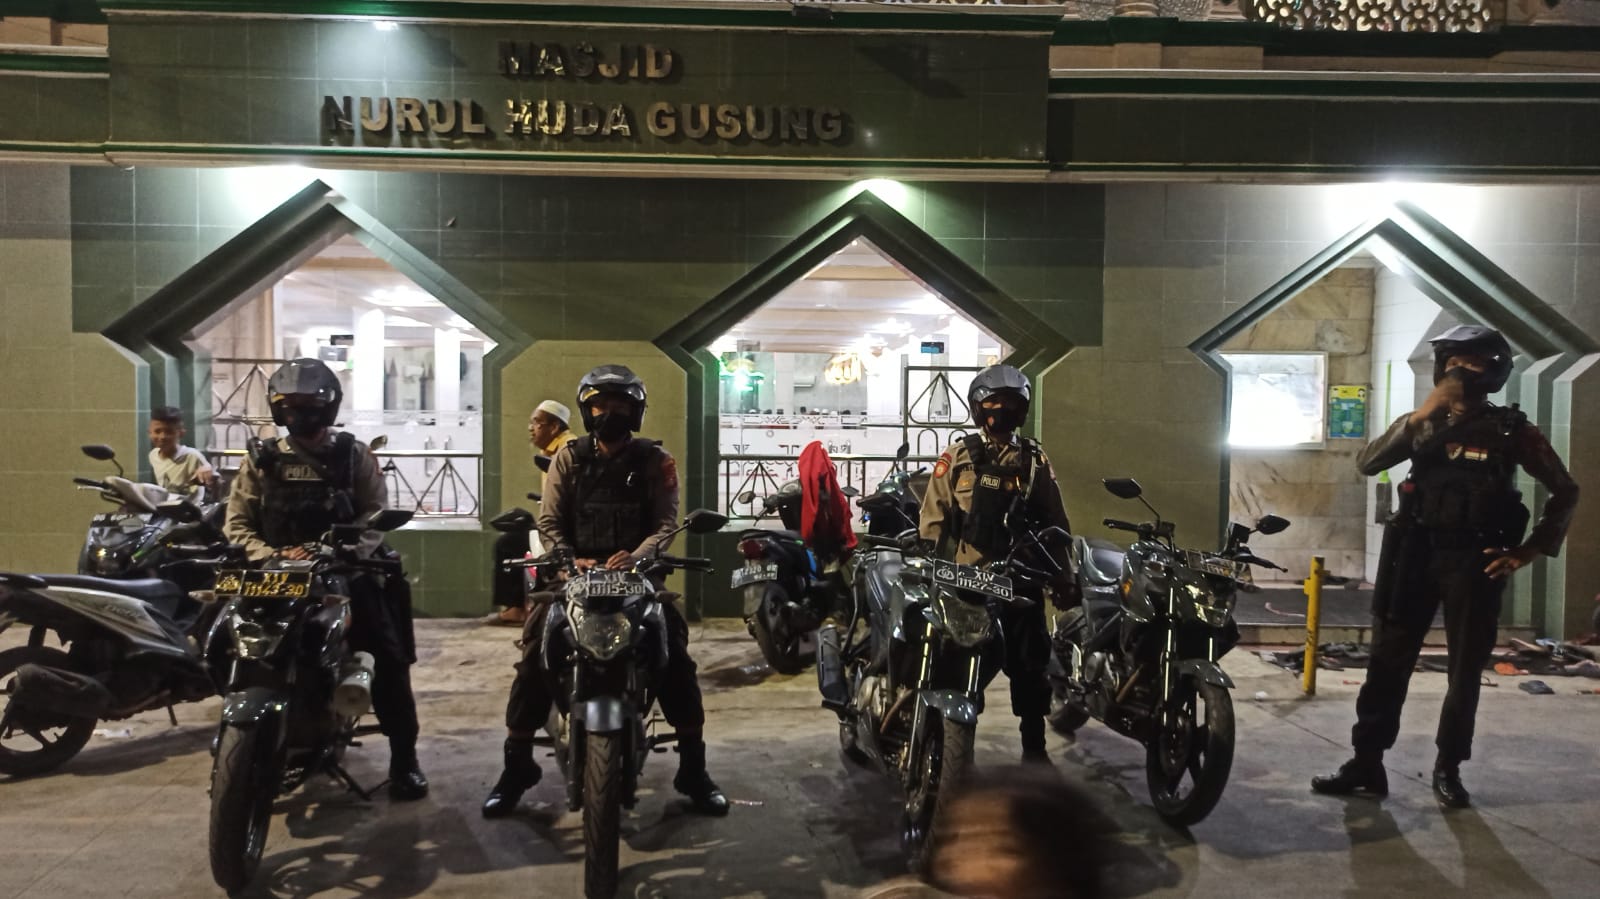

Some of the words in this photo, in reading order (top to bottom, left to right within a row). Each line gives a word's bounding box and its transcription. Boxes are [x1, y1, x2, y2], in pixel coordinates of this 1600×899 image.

[498, 40, 674, 78] MASJID
[321, 96, 486, 133] NURUL
[504, 99, 632, 136] HUDA
[646, 101, 842, 140] GUSUNG
